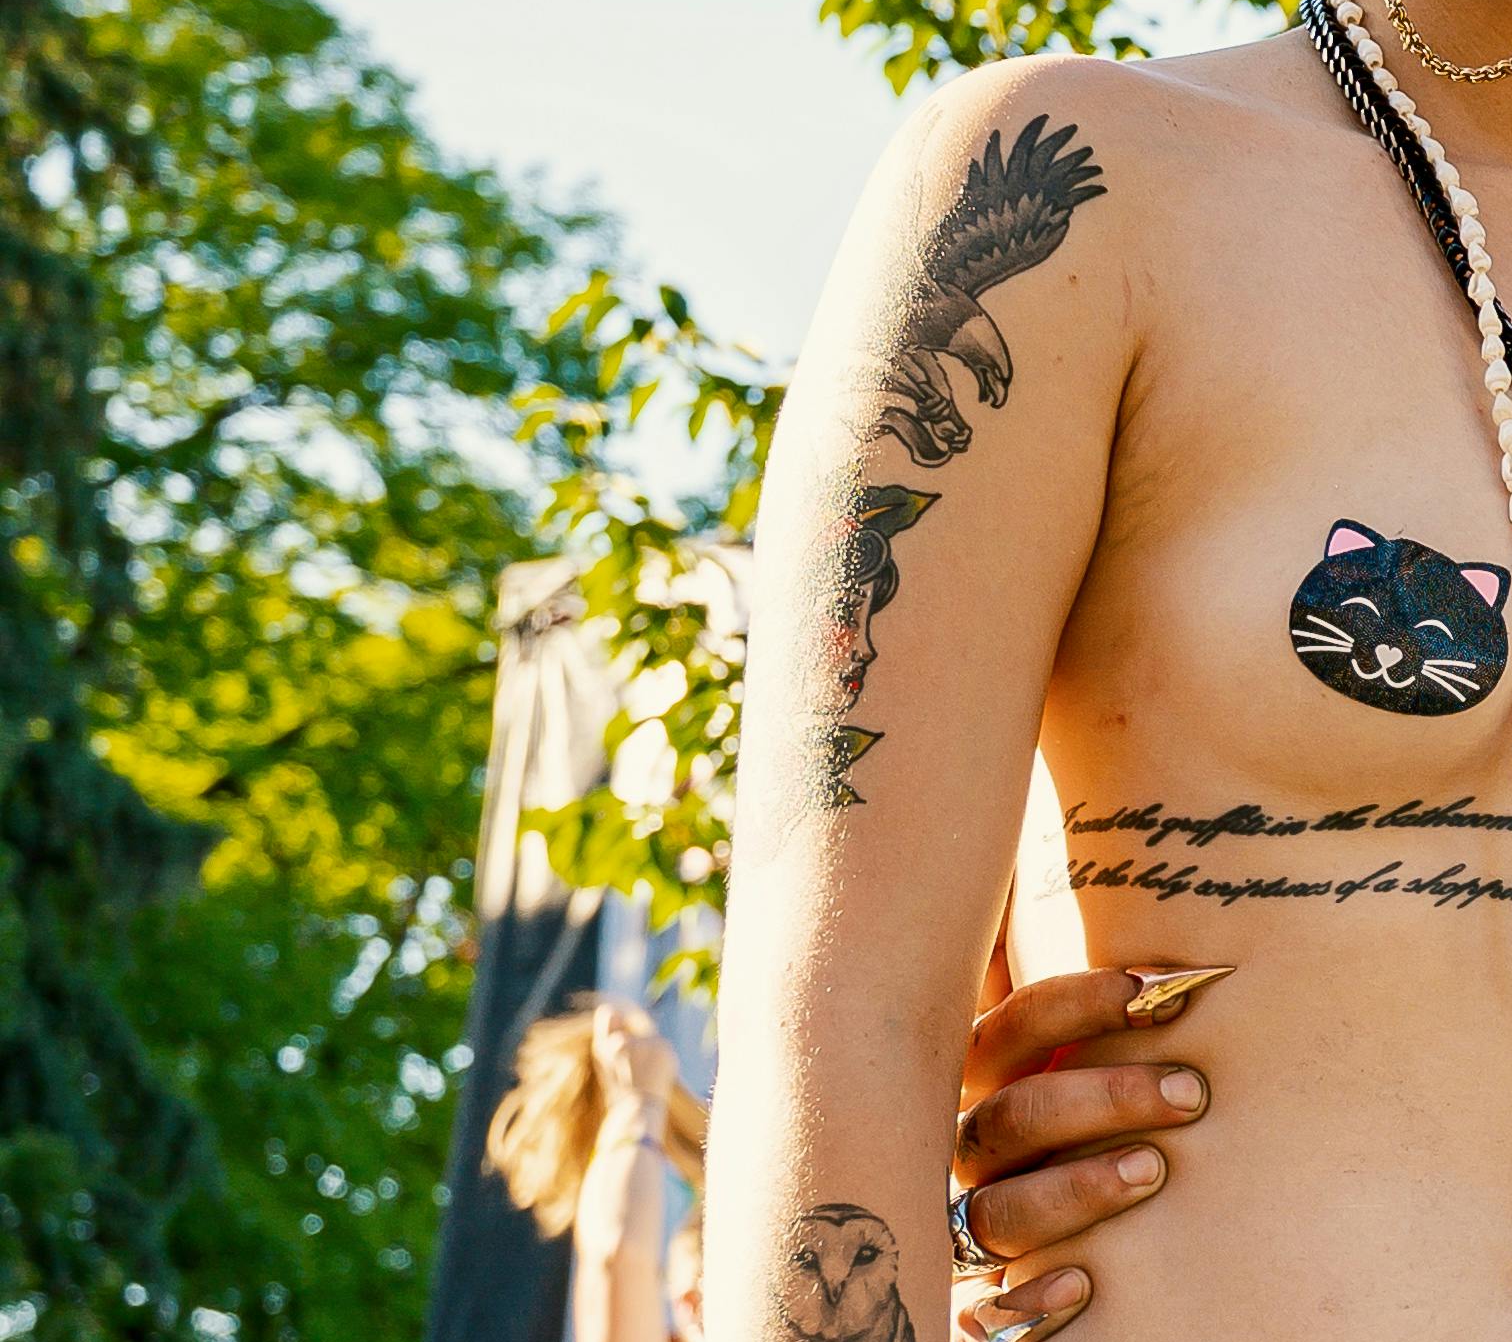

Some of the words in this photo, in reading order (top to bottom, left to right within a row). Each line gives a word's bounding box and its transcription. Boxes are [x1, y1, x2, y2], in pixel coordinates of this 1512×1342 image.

[1310, 803, 1380, 832] the
[1334, 861, 1404, 904] of
[1373, 877, 1400, 894] a
